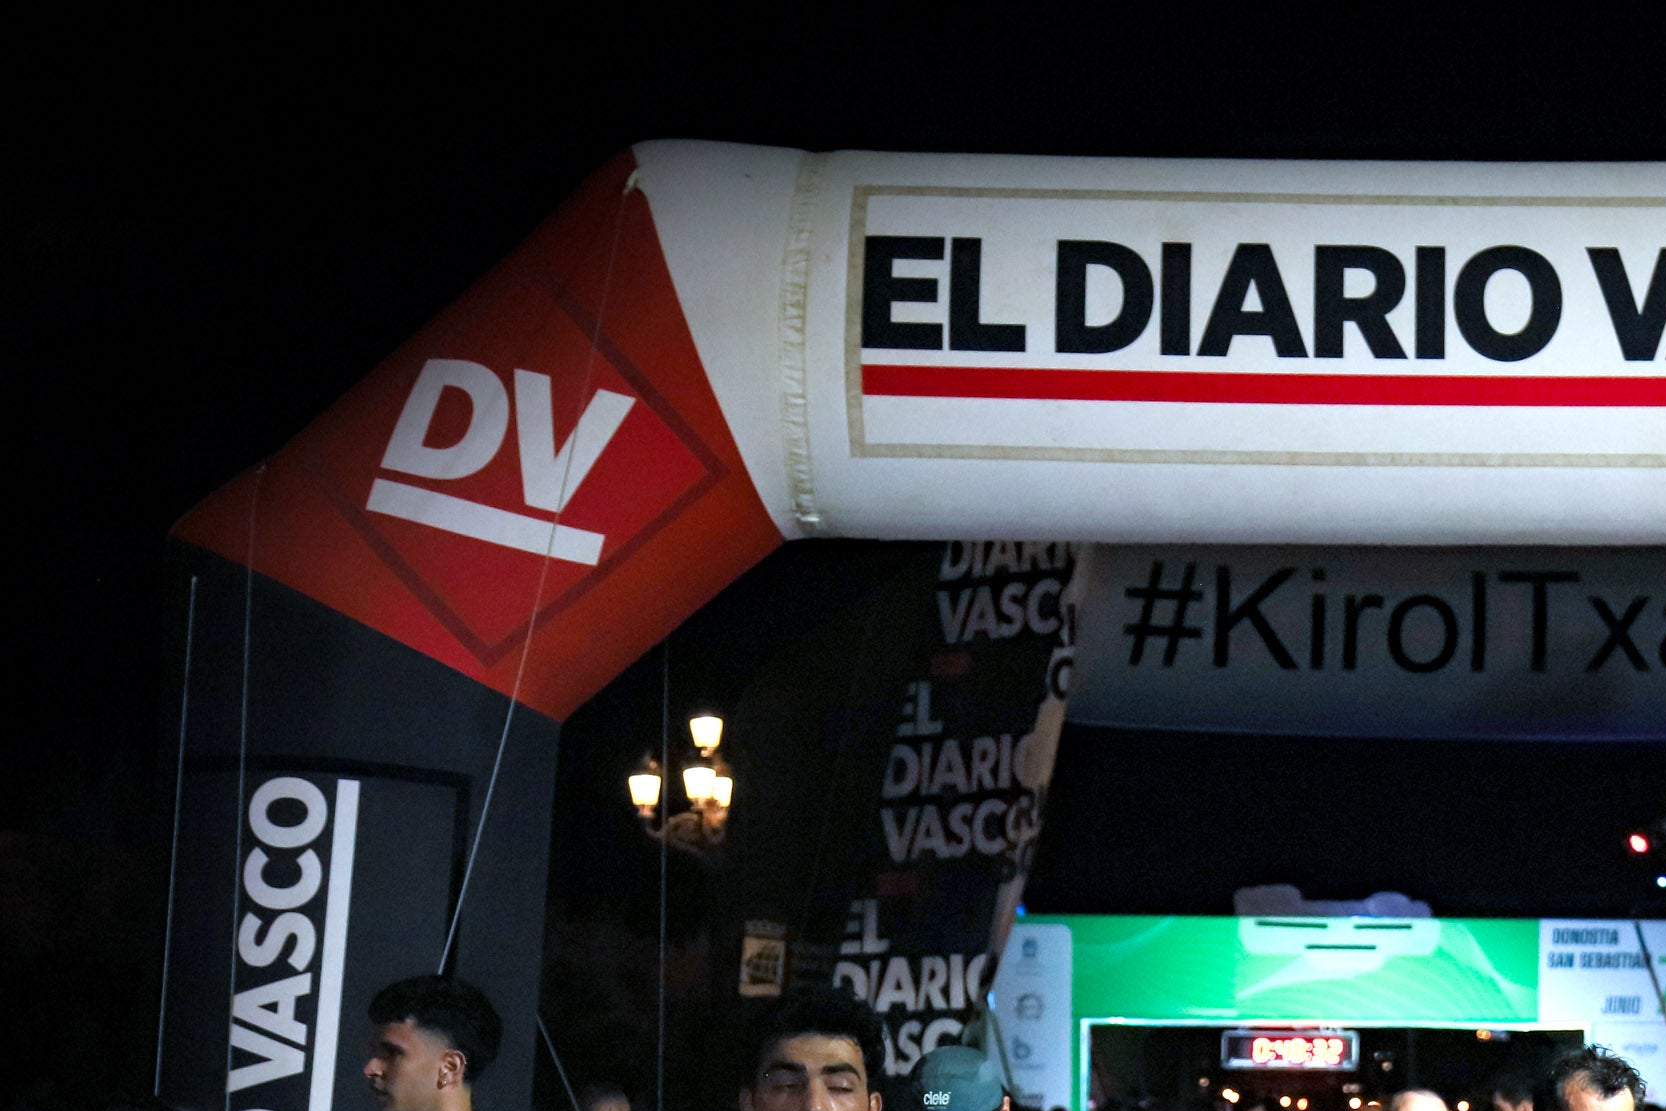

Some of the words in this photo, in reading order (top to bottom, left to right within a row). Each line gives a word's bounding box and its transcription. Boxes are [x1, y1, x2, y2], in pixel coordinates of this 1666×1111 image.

[861, 234, 1027, 353] EL
[1055, 238, 1564, 364] DIARIO
[379, 358, 638, 514] DV
[935, 577, 1062, 646] VASC
[225, 776, 329, 1094] VASCO
[1547, 950, 1575, 969] SAN
[1551, 927, 1619, 946] DONOSTIA
